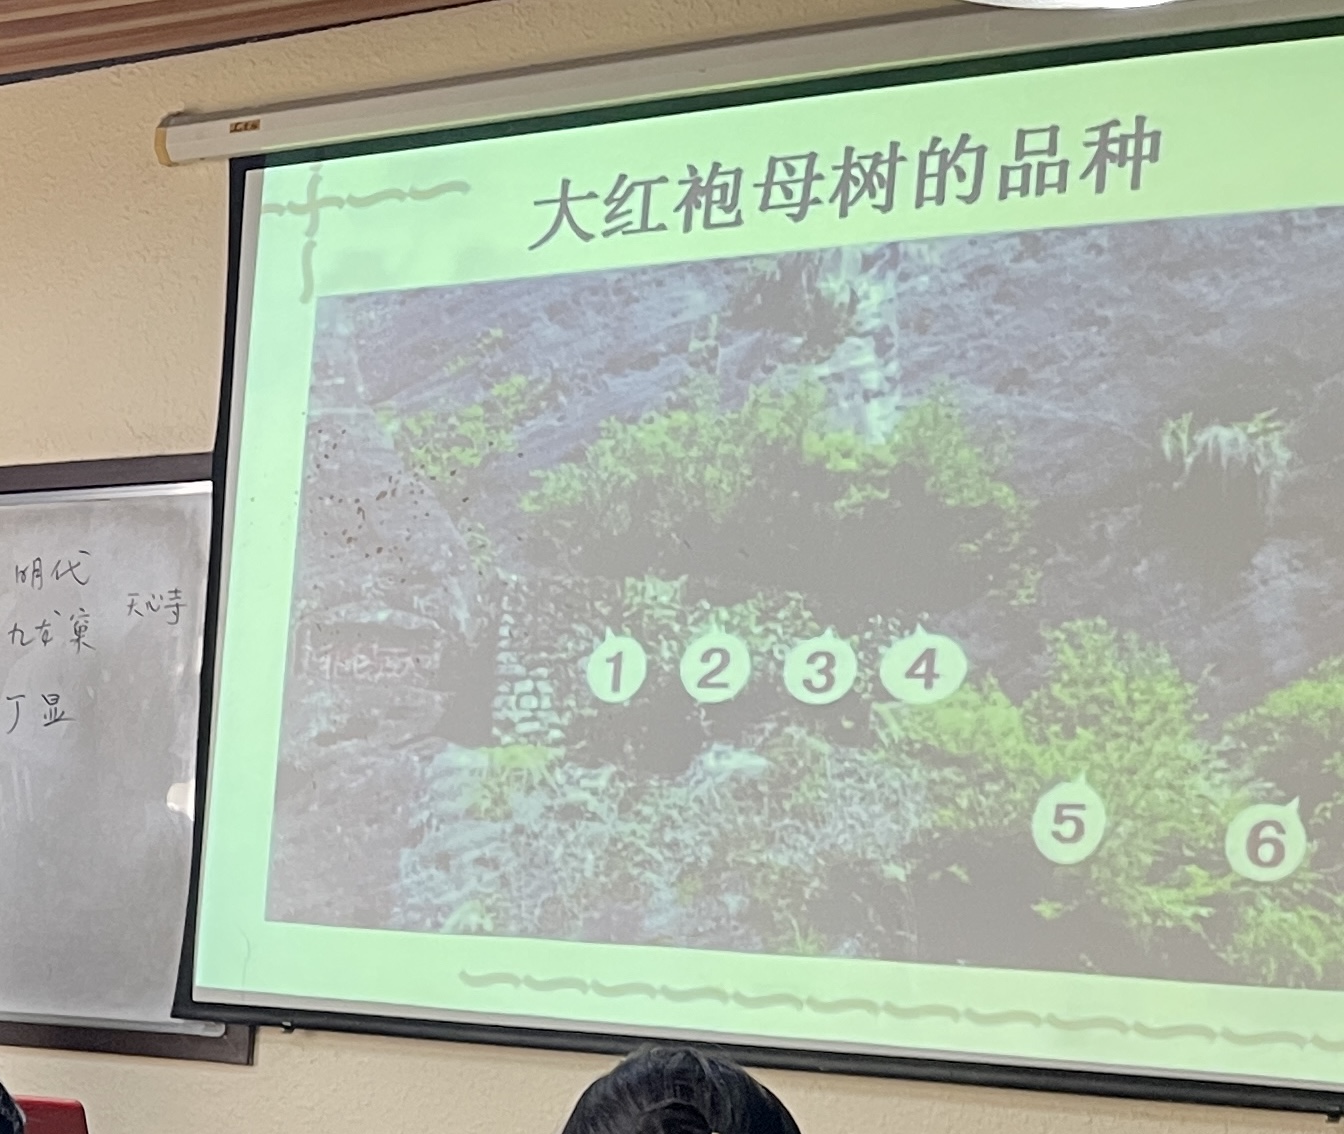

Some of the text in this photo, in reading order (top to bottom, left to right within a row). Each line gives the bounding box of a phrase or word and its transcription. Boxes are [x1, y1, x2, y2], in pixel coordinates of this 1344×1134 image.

[527, 115, 1163, 251] 大红袍母树的品种
[14, 550, 92, 591] 明代
[126, 588, 188, 626] 天心寺
[605, 646, 941, 695] 1 2 3 4
[5, 692, 77, 735] 丁显
[1050, 802, 1287, 869] 5 6
